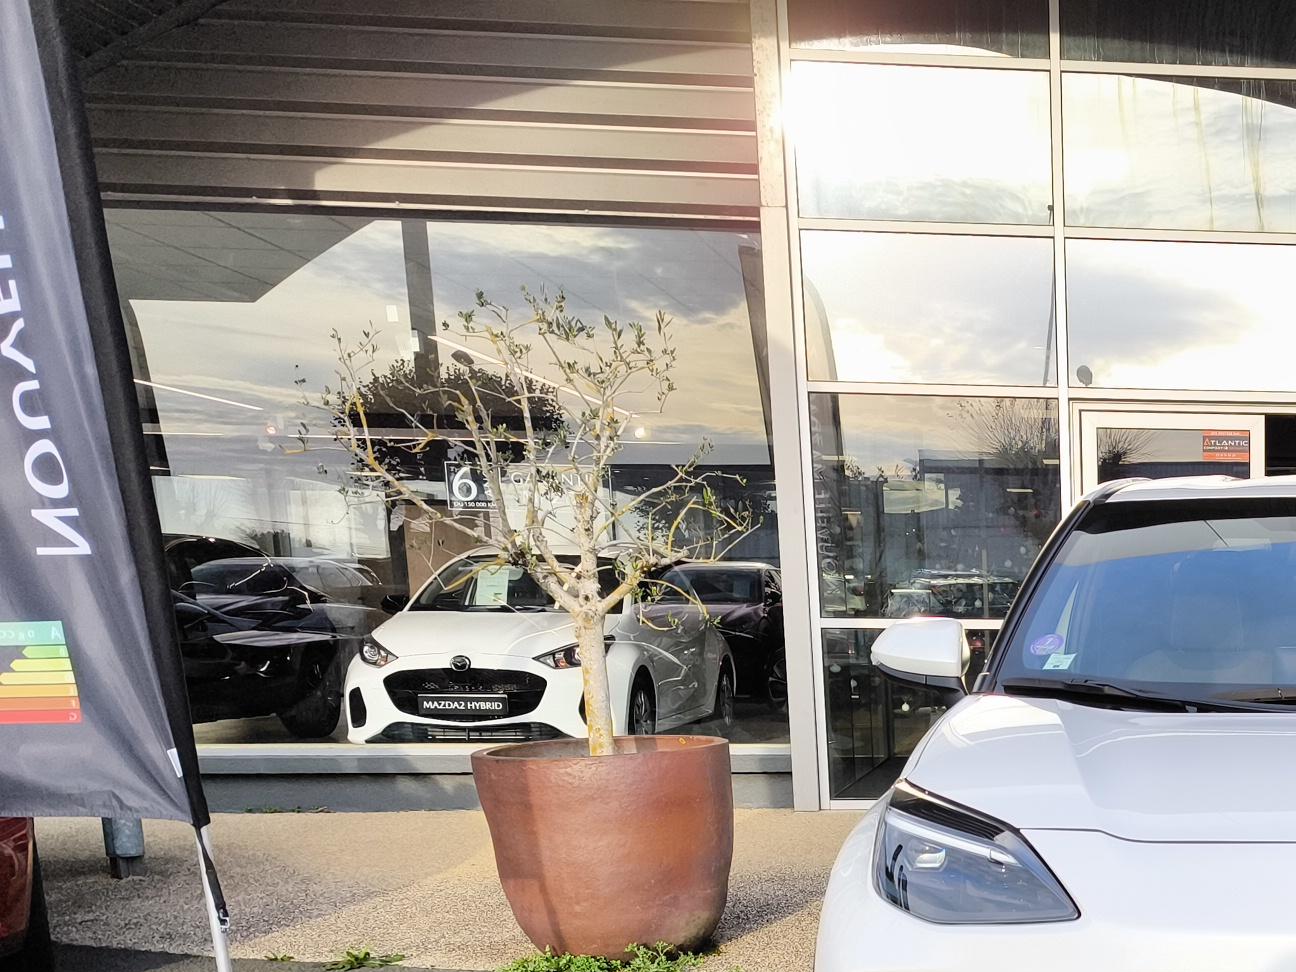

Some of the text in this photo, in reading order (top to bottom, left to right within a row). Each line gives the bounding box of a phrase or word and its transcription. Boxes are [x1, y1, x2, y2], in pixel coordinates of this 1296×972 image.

[1203, 438, 1249, 446] ATLANTIC
[452, 466, 478, 501] 6
[423, 701, 503, 710] MAZDA2 HYBRID
